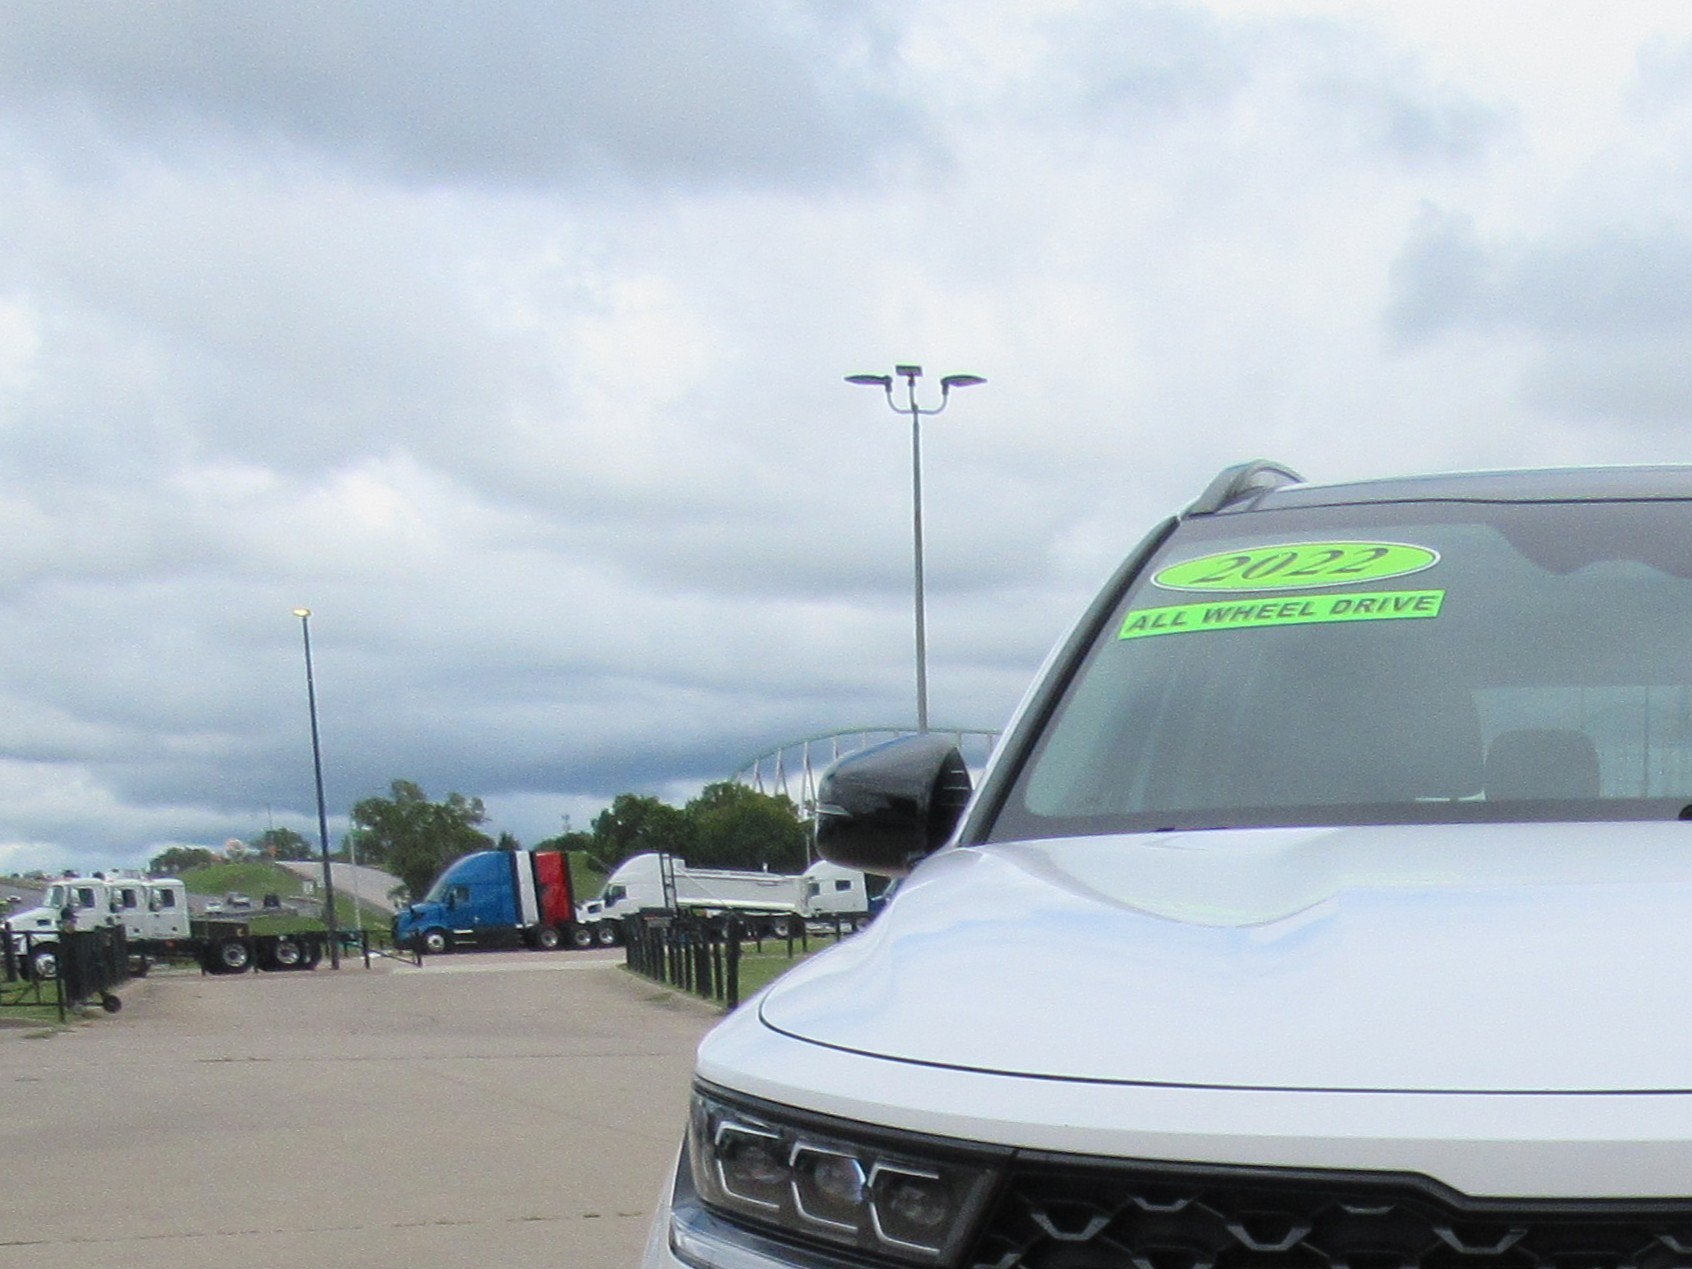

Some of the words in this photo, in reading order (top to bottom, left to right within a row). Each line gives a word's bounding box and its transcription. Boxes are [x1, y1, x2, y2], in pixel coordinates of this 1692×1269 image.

[1191, 547, 1389, 585] 2022
[1126, 613, 1188, 634] ALL
[1200, 600, 1316, 625] WHEEL
[1328, 594, 1437, 616] DRIVE
